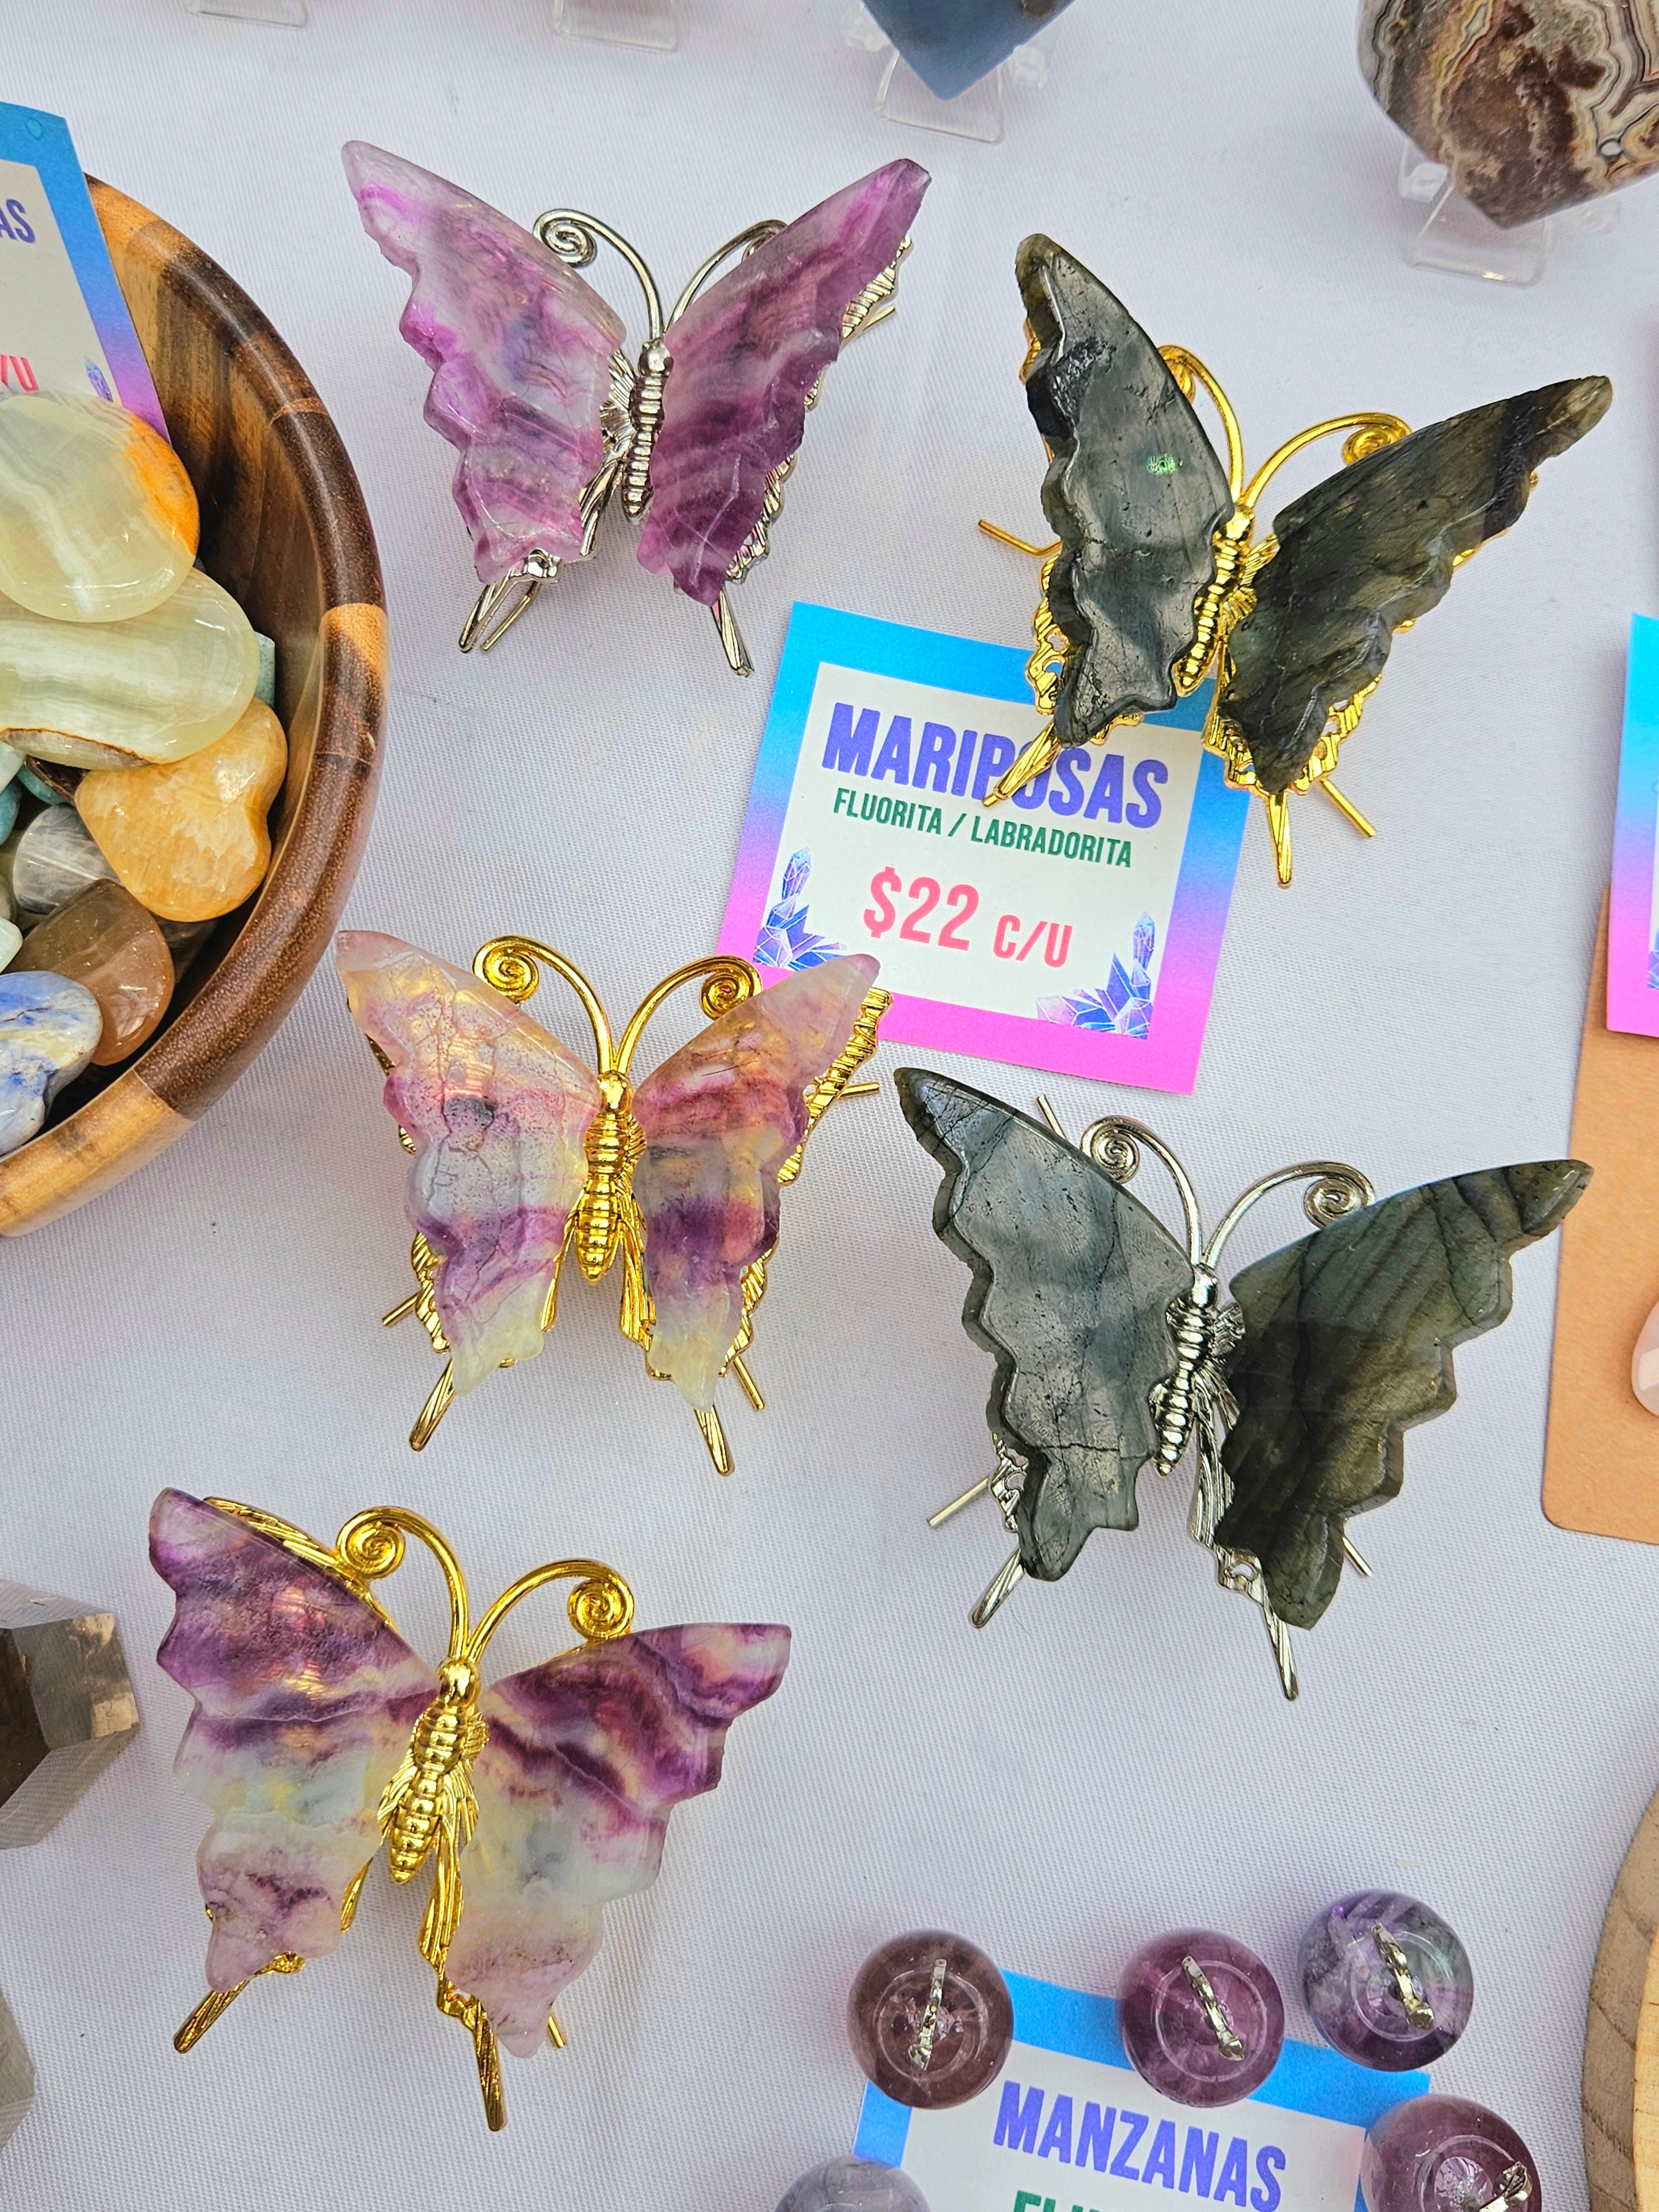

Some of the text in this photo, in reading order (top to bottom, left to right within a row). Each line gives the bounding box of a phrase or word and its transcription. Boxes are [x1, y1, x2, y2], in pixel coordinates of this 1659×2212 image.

[833, 787, 1131, 868] FLUORITA / LABRADORITA
[863, 866, 1073, 968] $22 C/U
[993, 2080, 1287, 2212] MANZANAS
